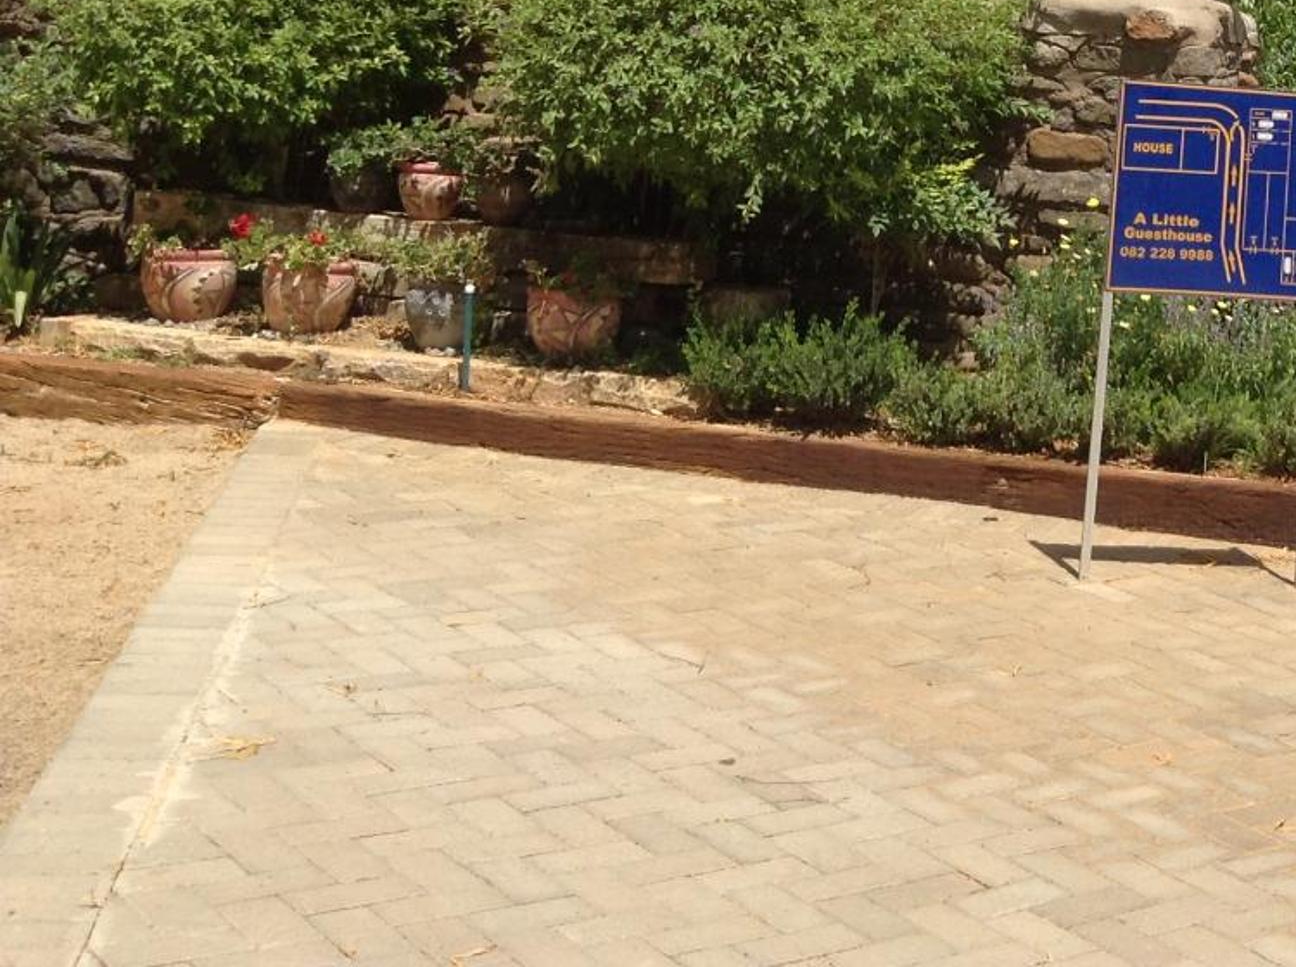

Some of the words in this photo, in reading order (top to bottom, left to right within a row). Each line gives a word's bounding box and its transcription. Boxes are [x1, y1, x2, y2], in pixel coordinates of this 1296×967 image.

[1133, 142, 1174, 154] HOUSE
[1133, 212, 1147, 225] A
[1152, 213, 1200, 227] Little
[1123, 227, 1213, 242] Guesthouse
[1119, 246, 1146, 258] 082
[1149, 247, 1176, 260] 228
